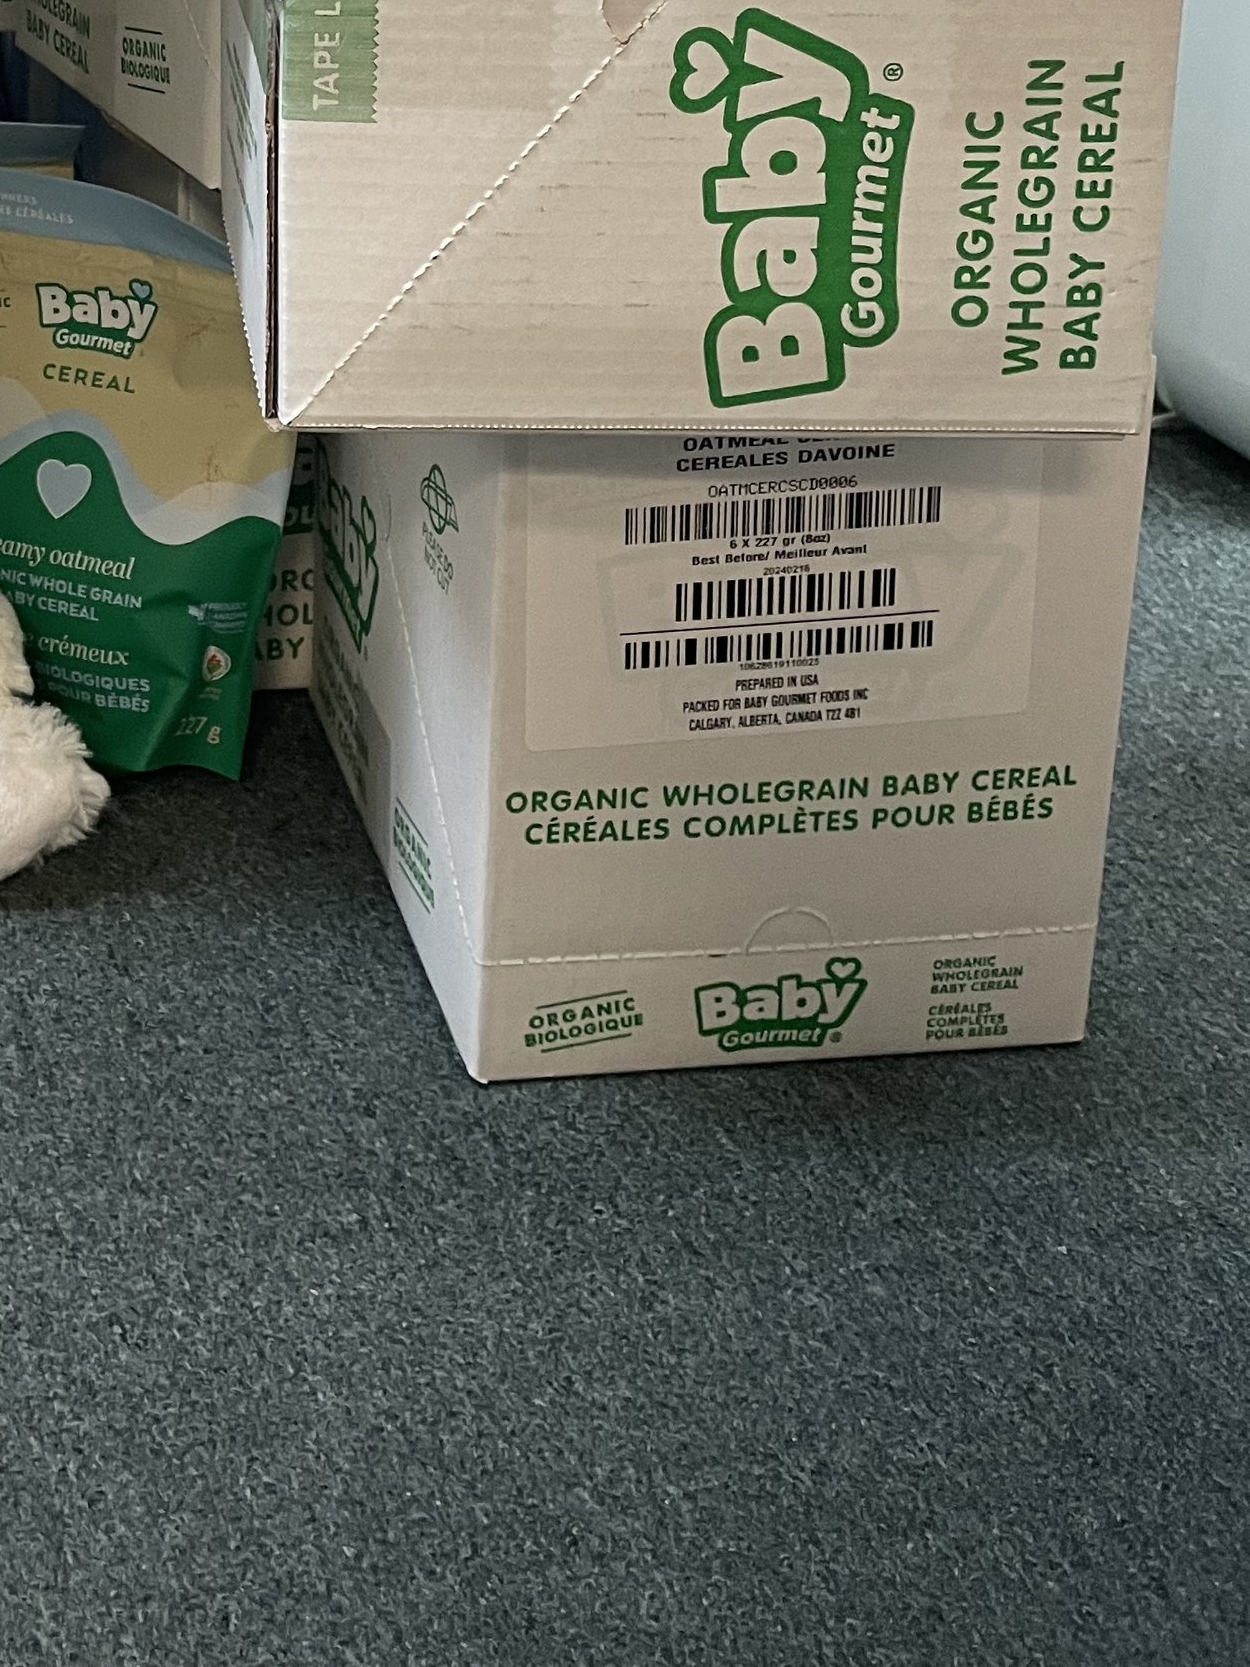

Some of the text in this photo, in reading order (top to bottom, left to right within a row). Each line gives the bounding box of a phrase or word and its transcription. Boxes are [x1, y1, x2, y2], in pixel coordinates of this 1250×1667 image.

[311, 30, 343, 113] TAPE
[702, 7, 870, 409] Baby
[840, 106, 901, 338] Gourmet
[950, 110, 1005, 328] ORGANIC
[1001, 59, 1067, 376] WHOLEGRAIN
[1058, 60, 1125, 371] BABY CEREAL
[35, 282, 158, 343] Baby
[54, 328, 133, 356] Gourmet
[42, 362, 136, 394] CEREAL
[49, 548, 136, 580] oatmeal
[505, 764, 1078, 814] ORGANIC WHOLEGRAIN BABY CEREAL
[523, 790, 1055, 846] CÉRÉALES COMPLÈTES POUR BÉBÉS
[694, 974, 868, 1034] Baby
[721, 1027, 822, 1048] Gourmet
